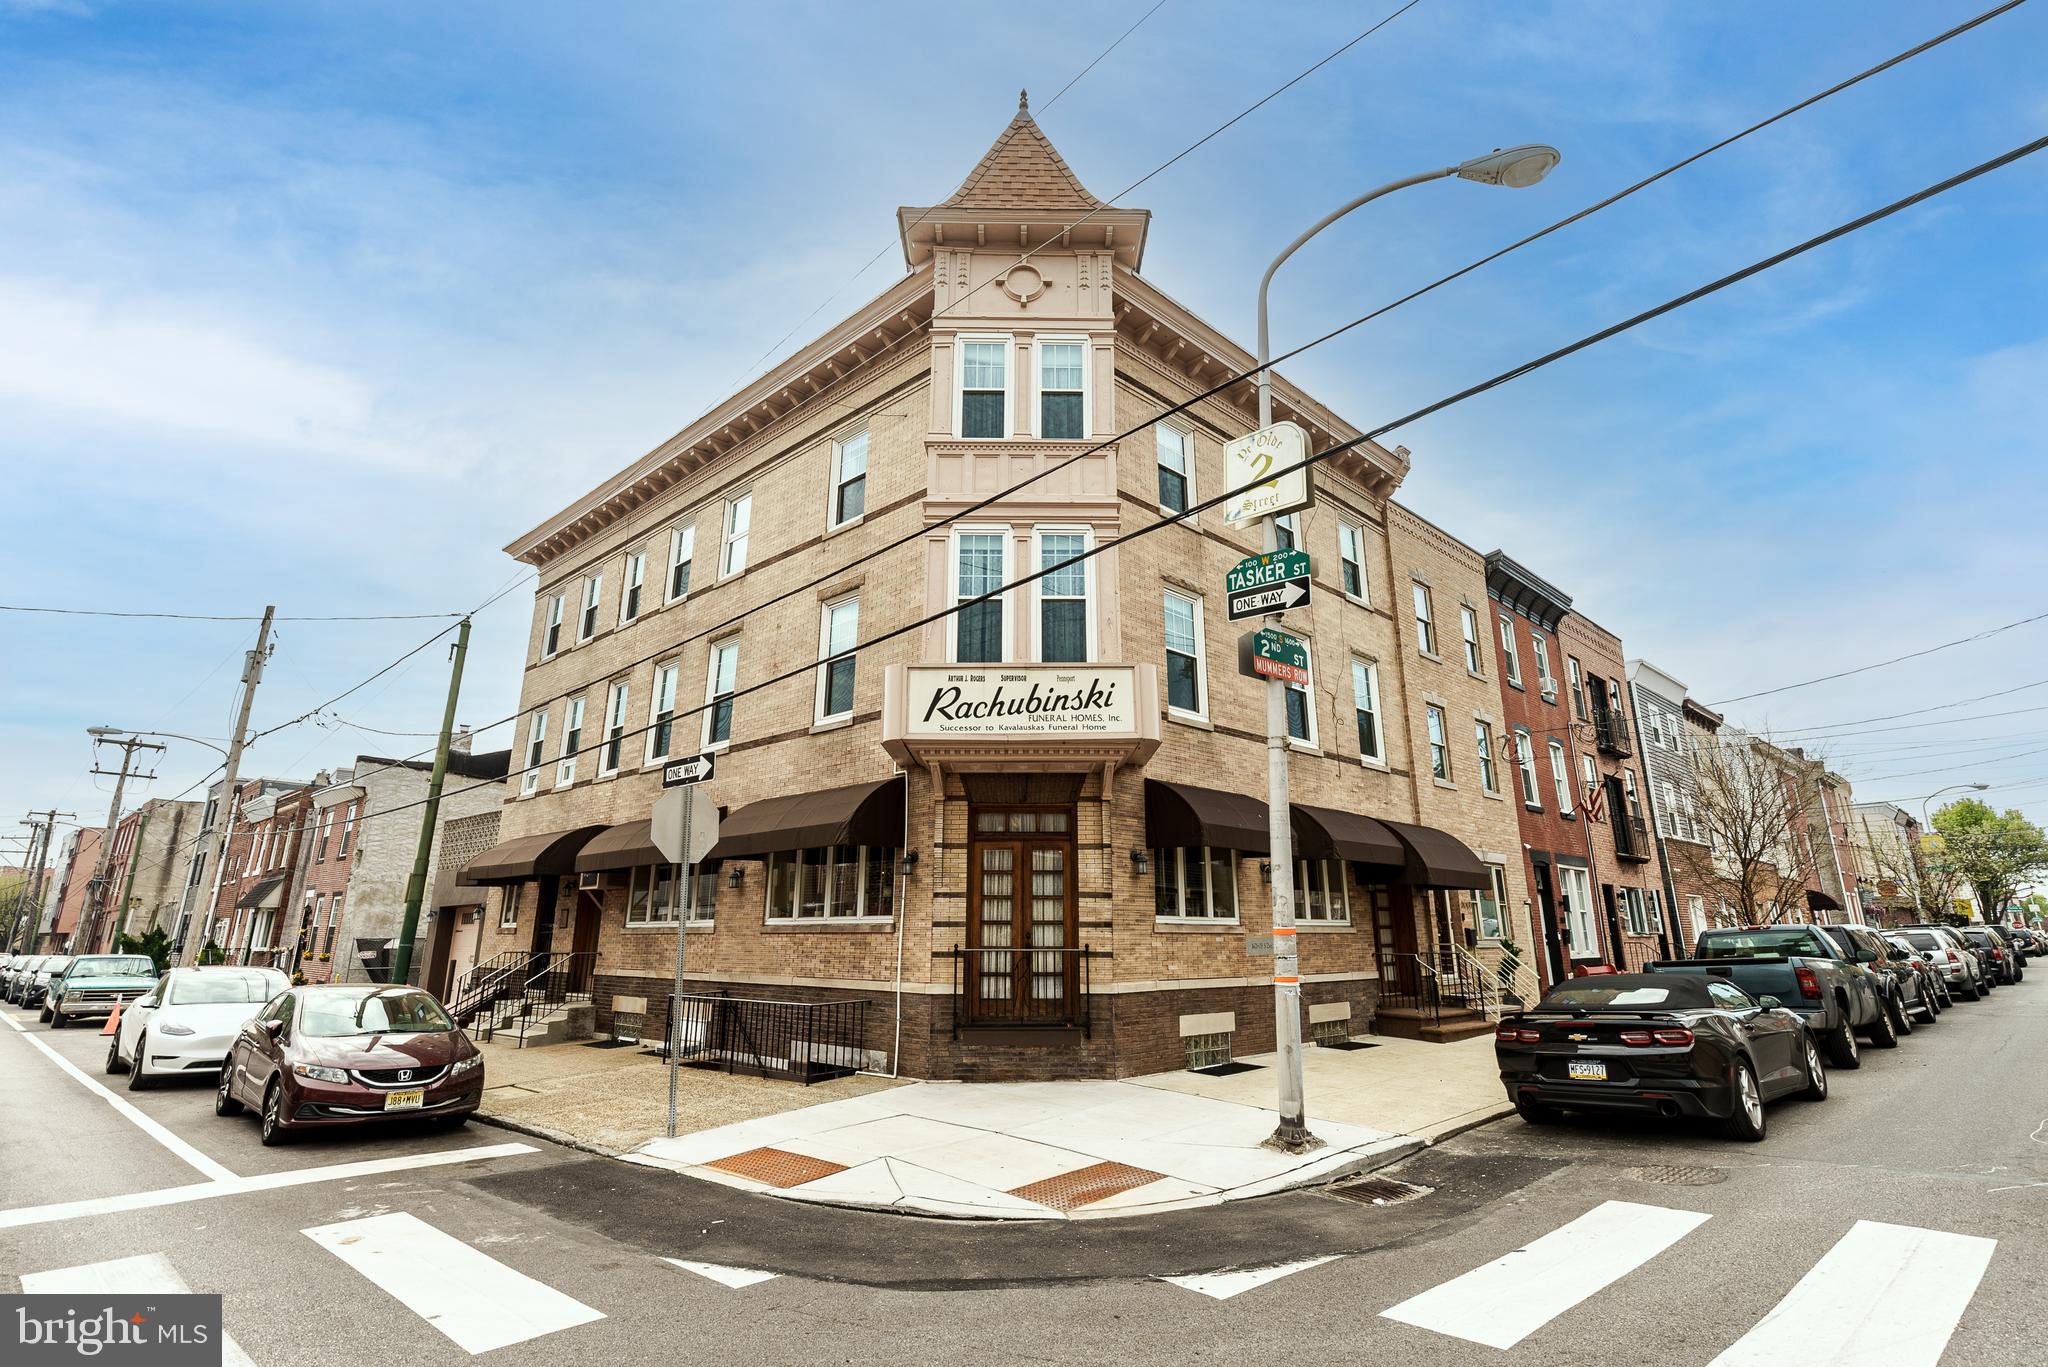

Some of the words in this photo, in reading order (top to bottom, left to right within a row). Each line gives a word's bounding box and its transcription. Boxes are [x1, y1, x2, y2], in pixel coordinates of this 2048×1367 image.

[1245, 453, 1279, 495] 2
[1242, 493, 1280, 511] Street
[1245, 560, 1258, 568] 100
[1261, 555, 1270, 565] W
[1272, 552, 1288, 562] 200
[1229, 562, 1286, 590] TASKER
[1293, 562, 1307, 576] ST
[1261, 639, 1282, 658] 2ND
[1293, 653, 1304, 667] ST
[970, 674, 986, 682] ROGERS
[1000, 674, 1027, 682] SUPERVISOR
[1256, 658, 1292, 679] MUMMERS
[1293, 669, 1308, 683] ROW
[923, 678, 1116, 722] Rachubinski
[1028, 714, 1067, 722] FUNERAL
[1108, 714, 1123, 722] Inc.
[998, 723, 1045, 731] Kavalauskas
[1048, 723, 1078, 731] Funeral
[668, 767, 682, 780] ONE
[684, 763, 699, 776] WAY
